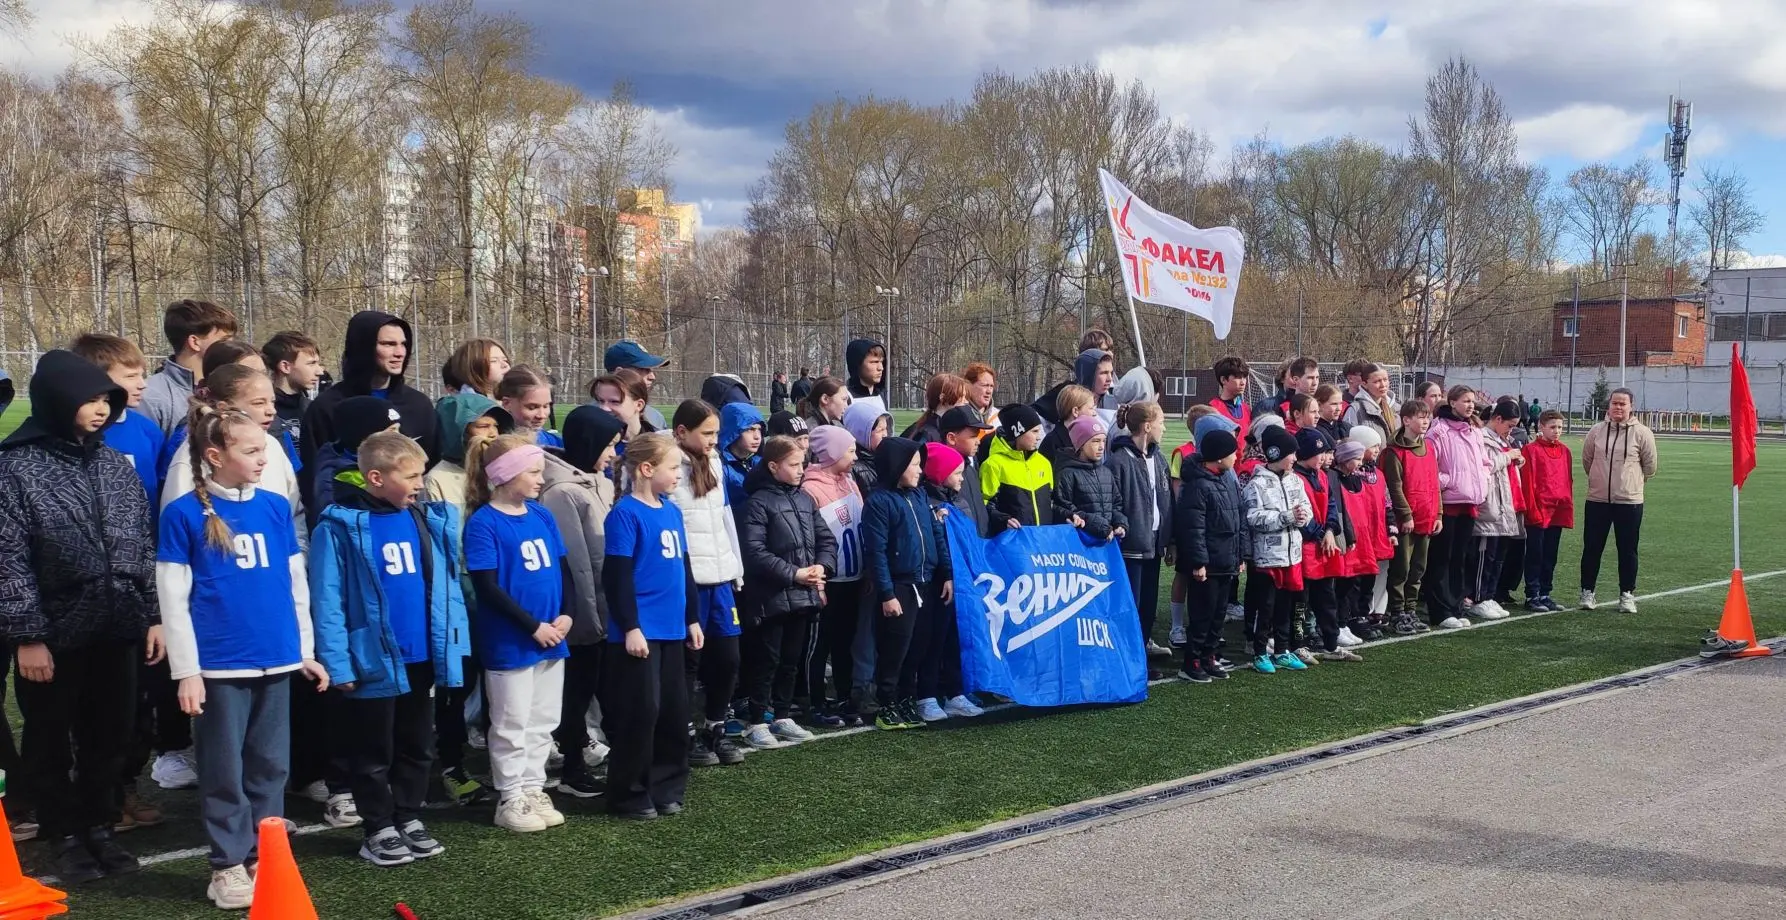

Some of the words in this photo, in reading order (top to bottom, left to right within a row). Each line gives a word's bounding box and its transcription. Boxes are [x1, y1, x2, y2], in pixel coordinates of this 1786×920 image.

[1142, 237, 1225, 274] ФАКЕЛ
[1011, 421, 1026, 438] 24
[235, 533, 270, 569] 91
[382, 541, 417, 576] 91
[520, 538, 551, 572] 91
[660, 530, 682, 559] 91
[1031, 553, 1065, 568] МАОУ
[1068, 553, 1087, 570] СОШ
[1076, 617, 1114, 650] ШСК
